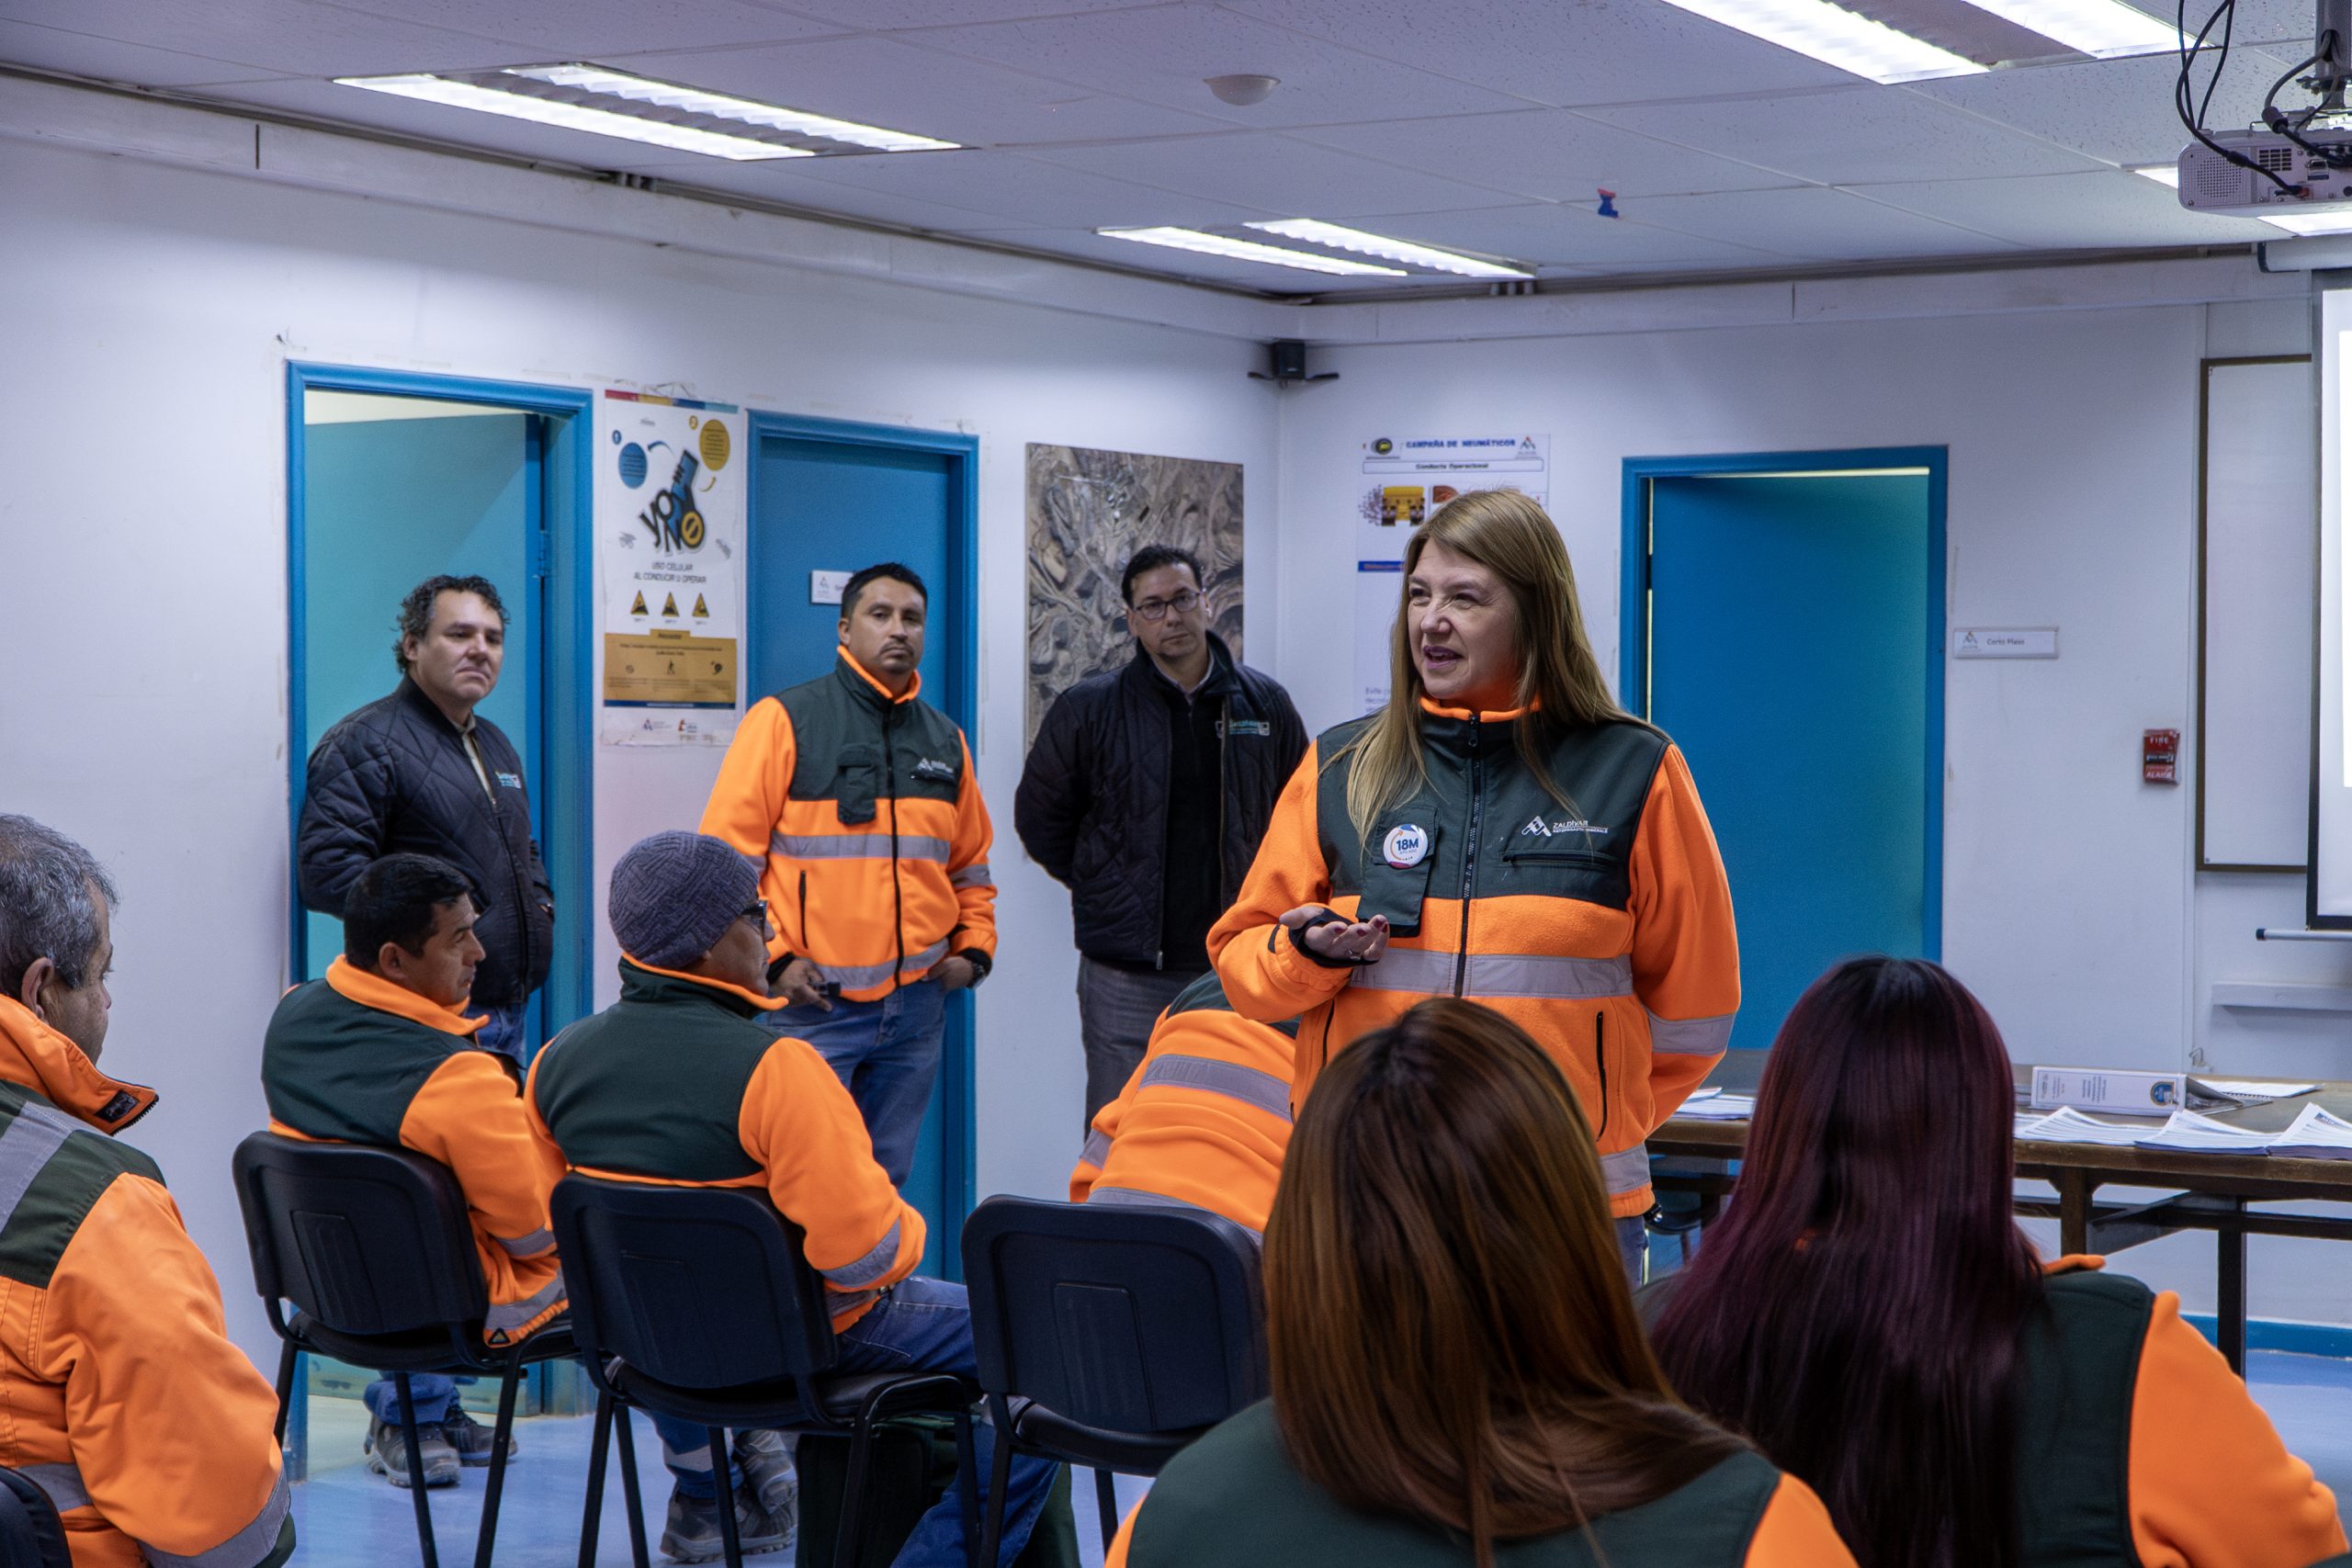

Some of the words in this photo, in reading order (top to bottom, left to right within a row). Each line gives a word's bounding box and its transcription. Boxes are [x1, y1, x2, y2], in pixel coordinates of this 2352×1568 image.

[1407, 439, 1444, 448] CAMPAÑA
[1462, 438, 1515, 447] NEUMÁTICOS
[652, 561, 665, 570] USO
[666, 562, 693, 571] CELULAR
[634, 571, 642, 581] AL
[643, 572, 675, 581] CONDUCIR
[683, 574, 707, 583] OPERAR
[1553, 819, 1589, 829] ZALDÍVAR
[1396, 838, 1419, 851] 18M
